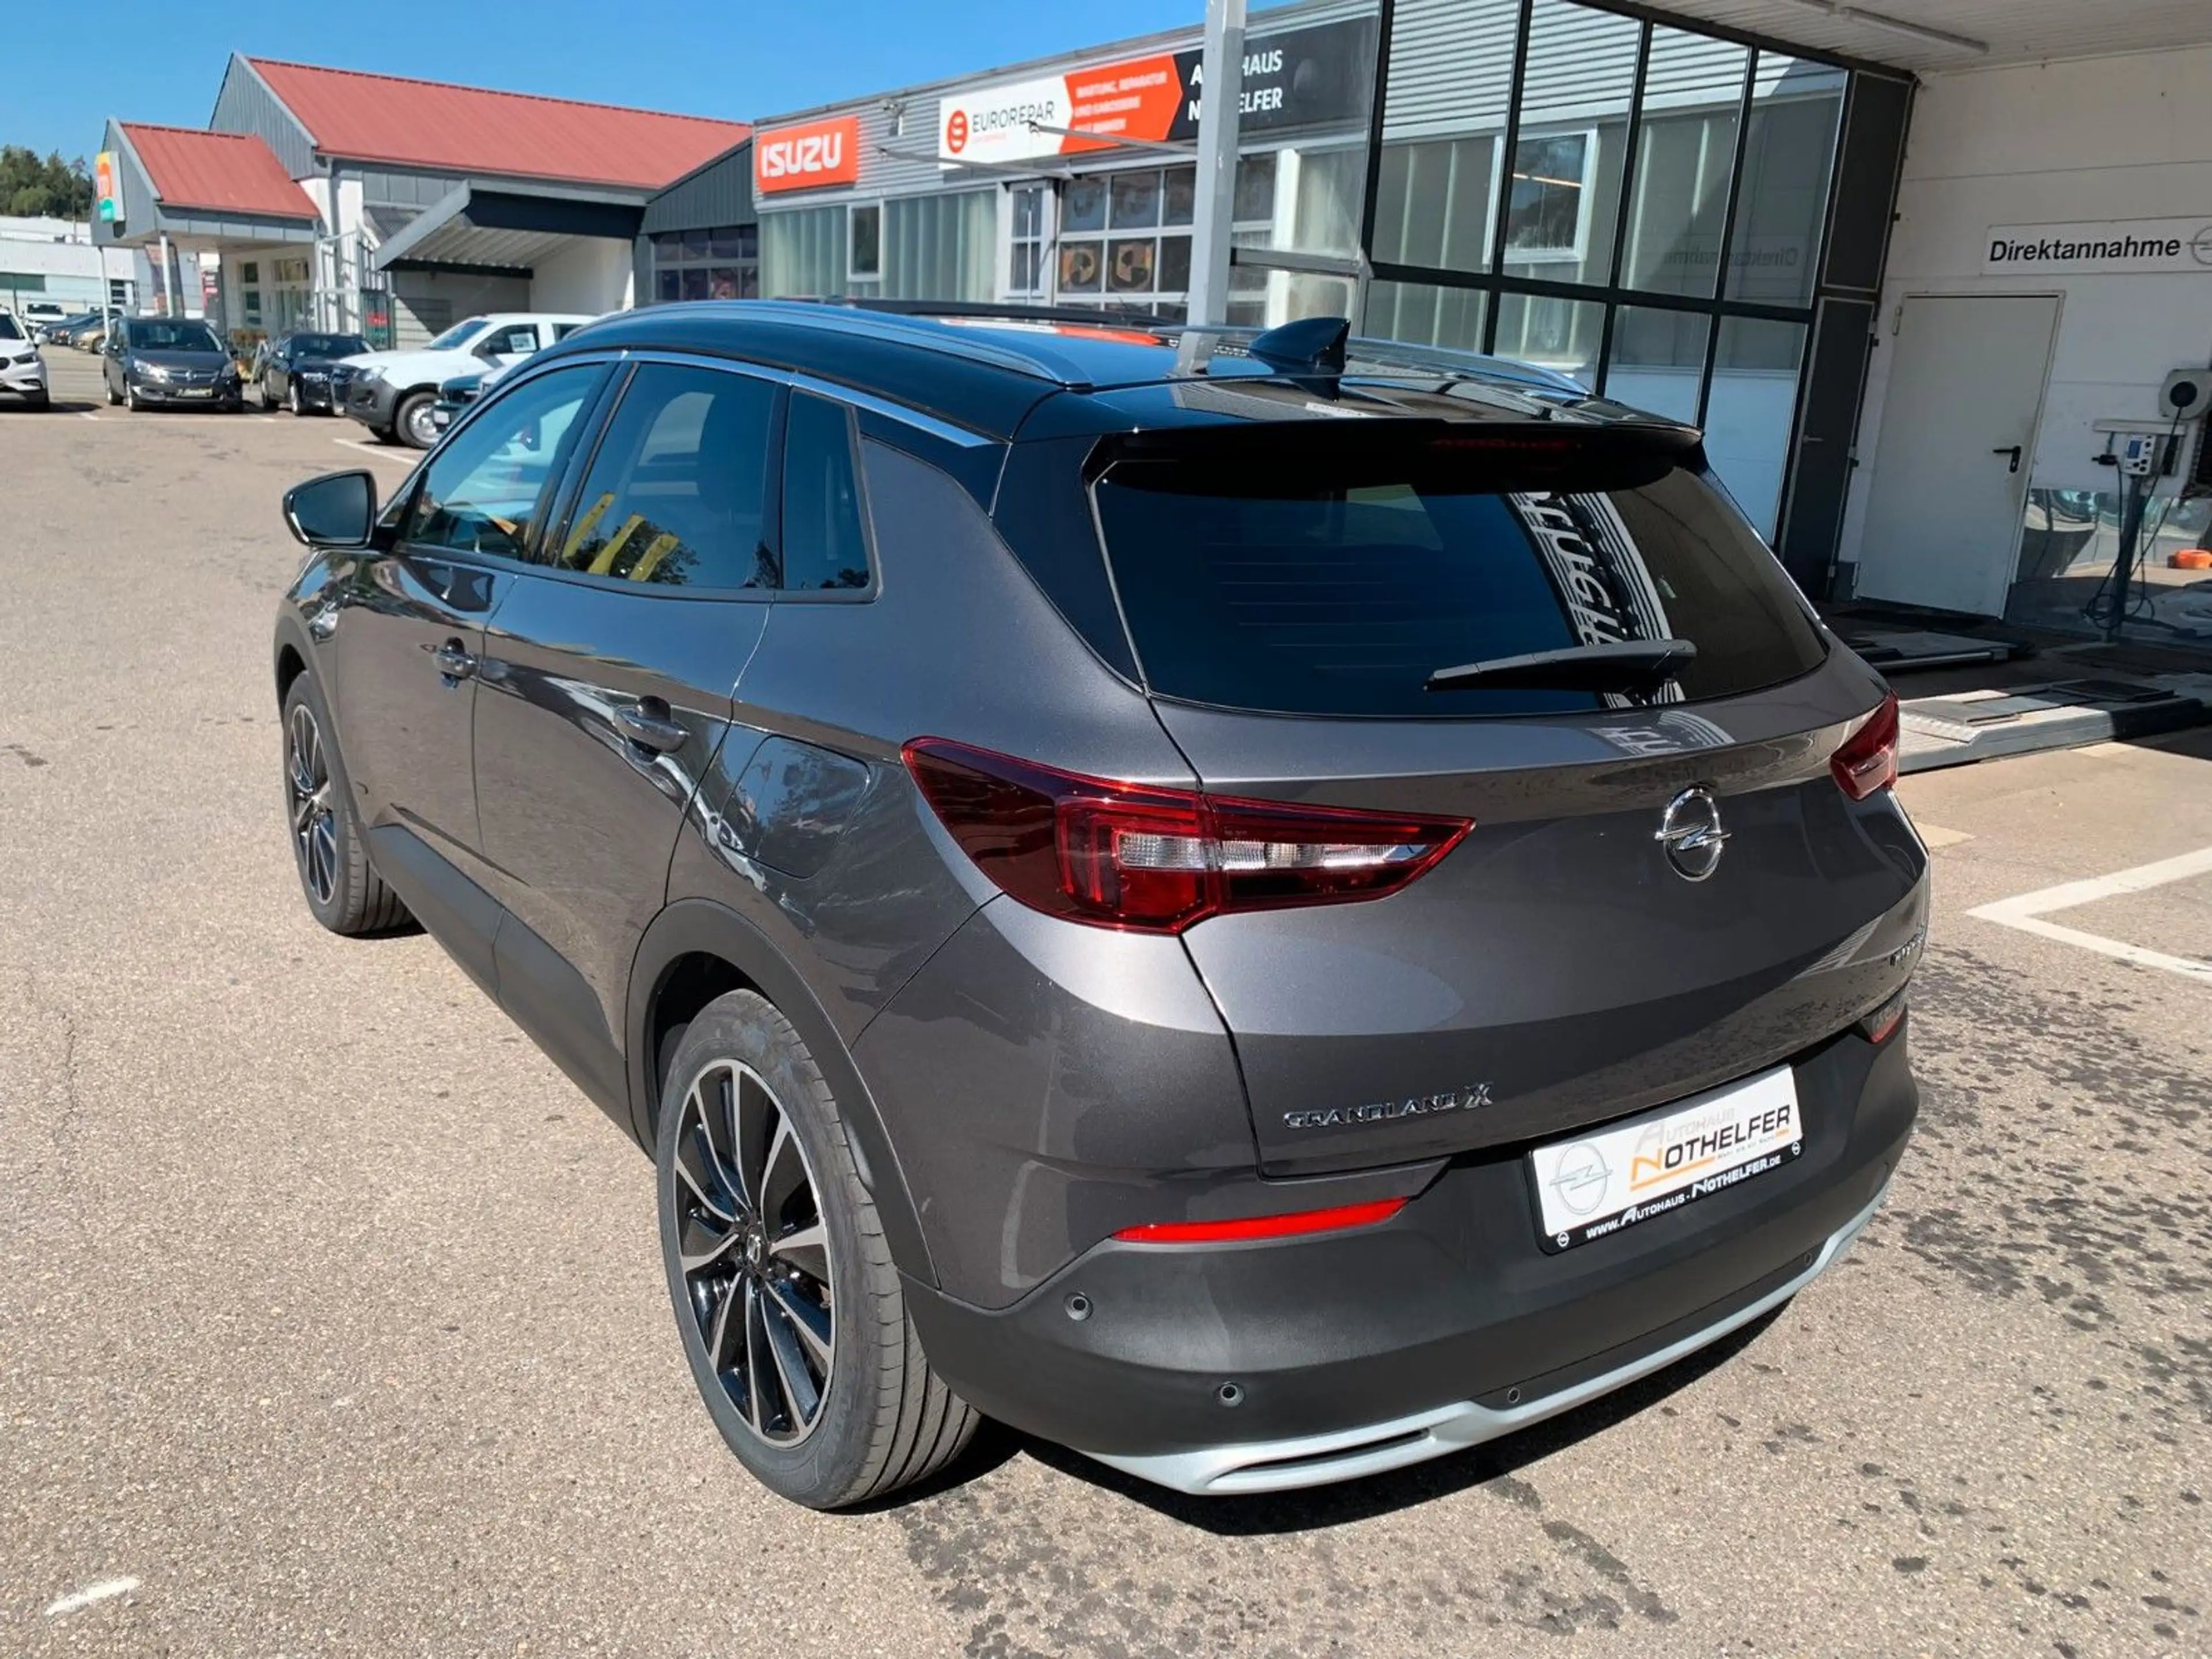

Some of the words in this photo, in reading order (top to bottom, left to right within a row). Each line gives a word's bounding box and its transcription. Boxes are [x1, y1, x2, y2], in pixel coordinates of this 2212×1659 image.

[972, 101, 1055, 133] EUROREPAR
[761, 131, 843, 178] ISUZU
[1990, 235, 2181, 262] Direktannahme
[1283, 1093, 1457, 1128] GRANDLAND
[1464, 1081, 1494, 1109] X
[1630, 1104, 1791, 1181] NOTHELFER
